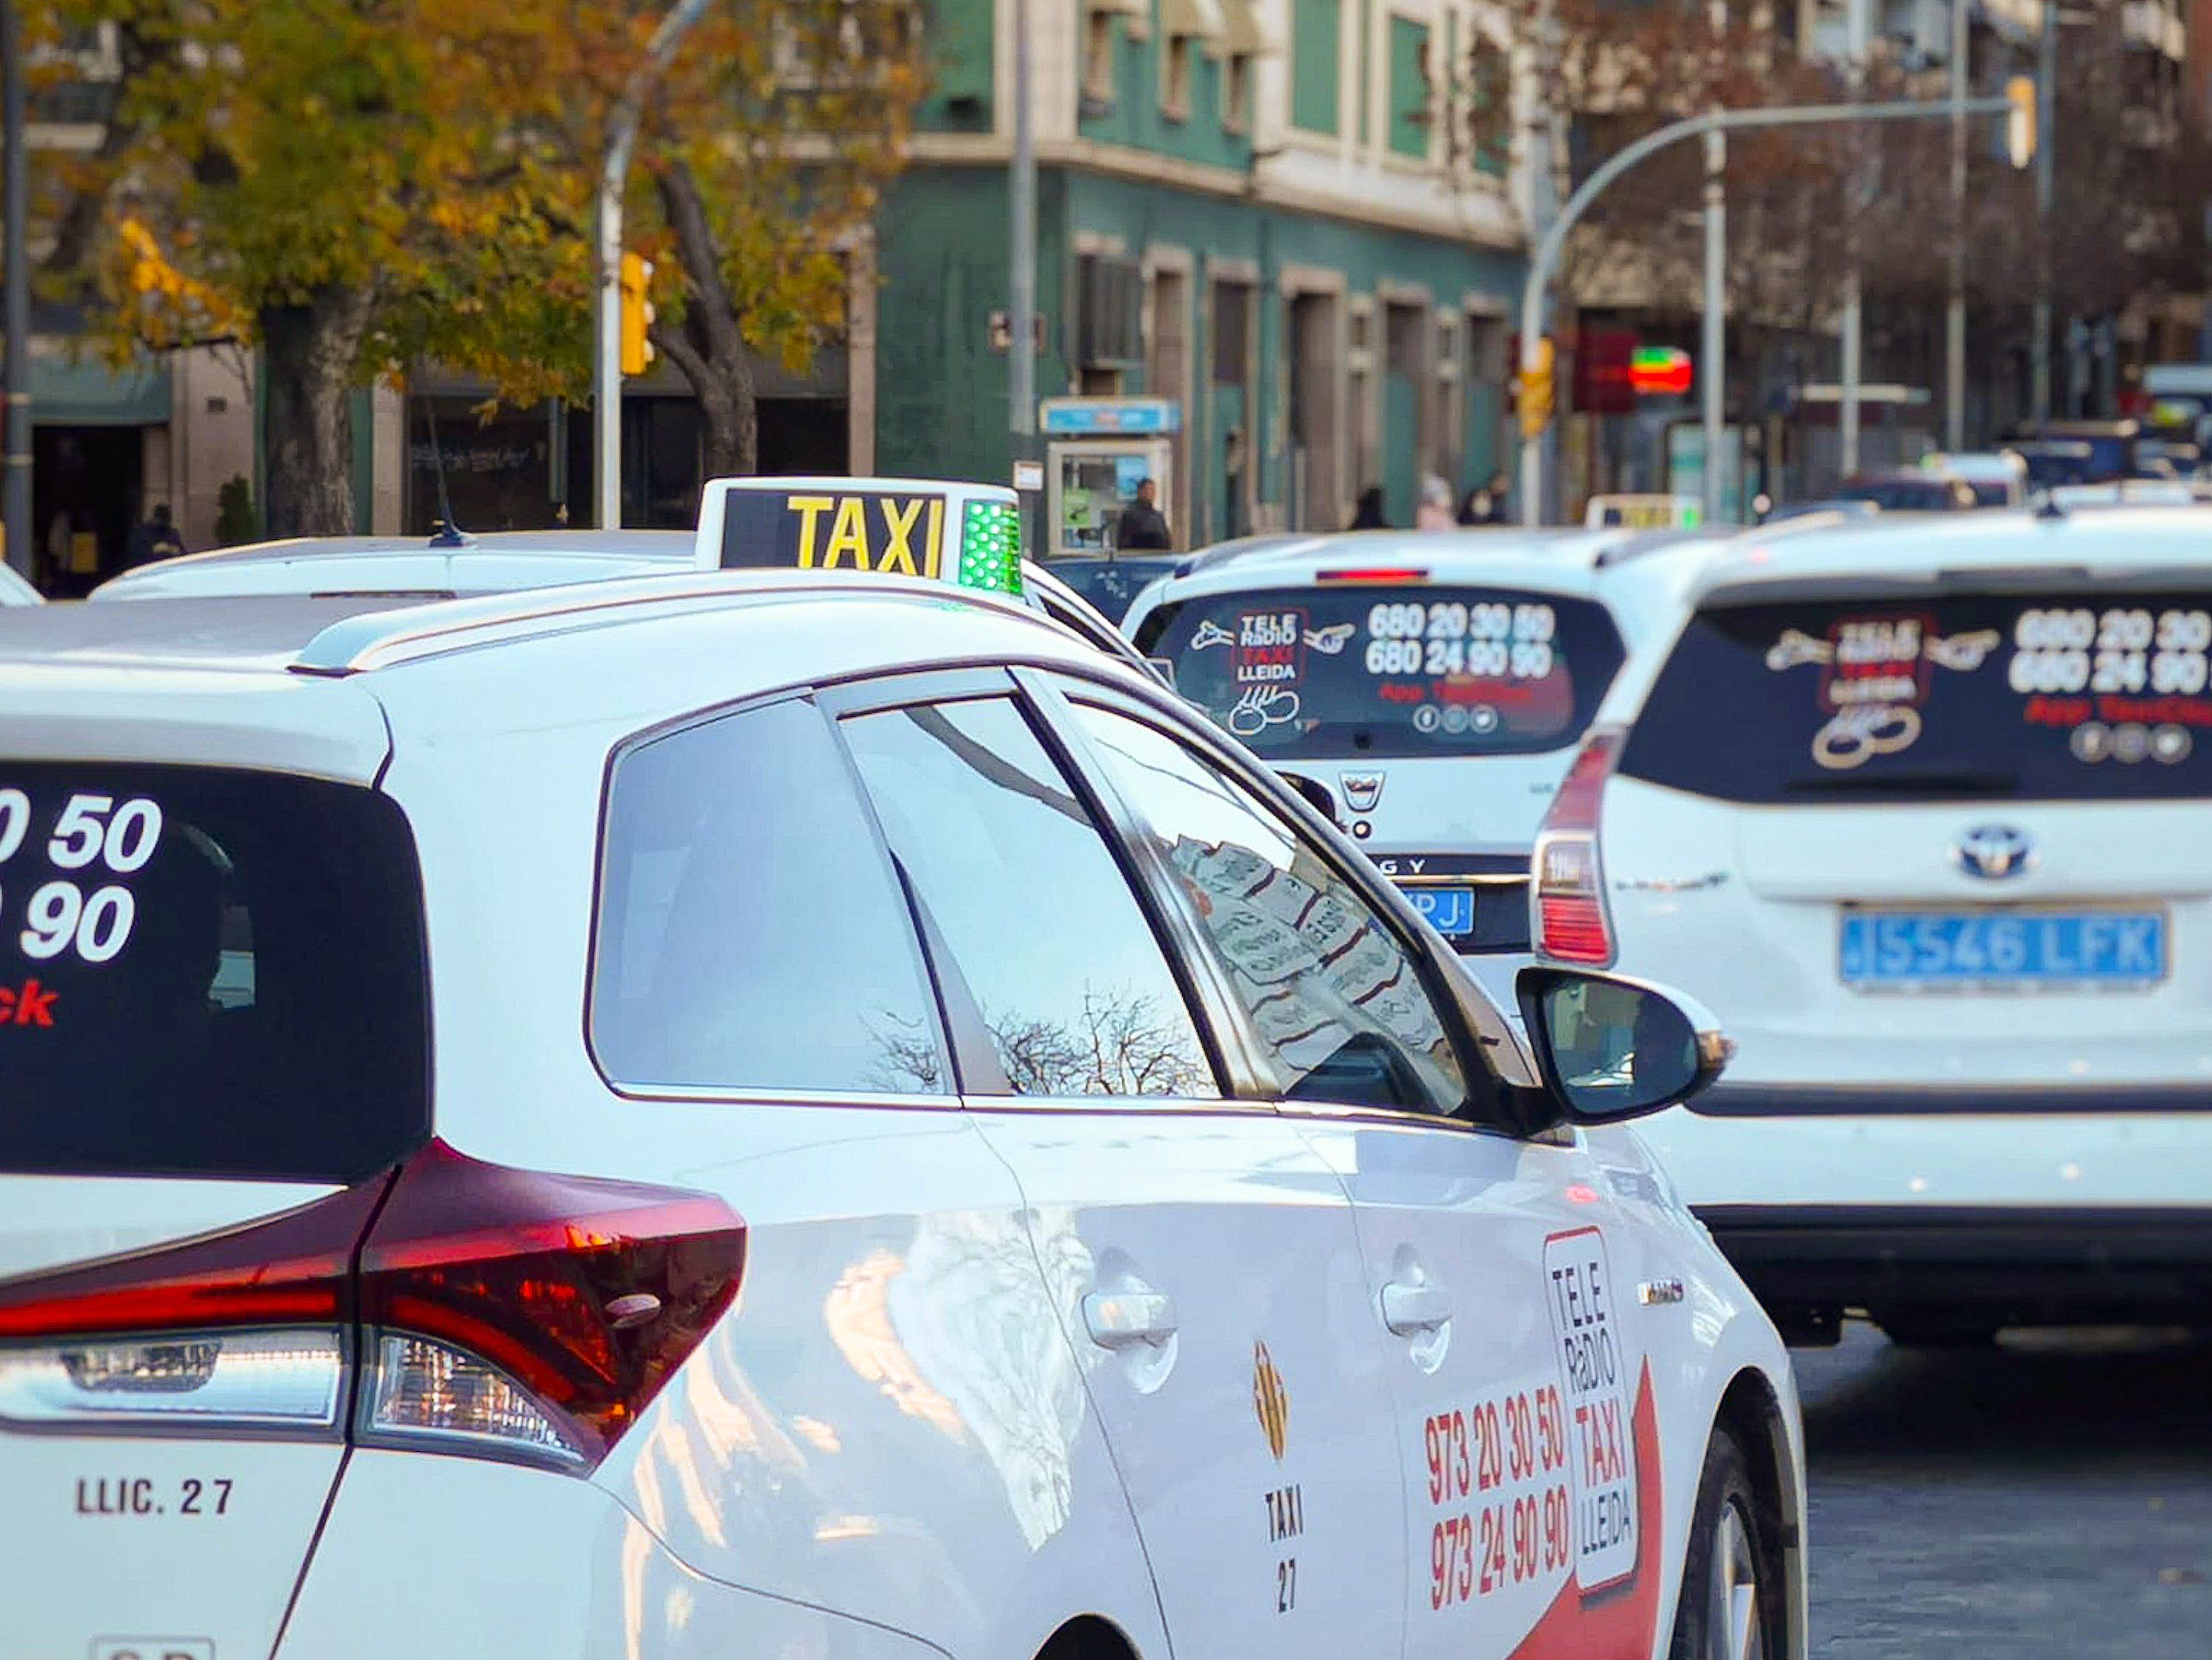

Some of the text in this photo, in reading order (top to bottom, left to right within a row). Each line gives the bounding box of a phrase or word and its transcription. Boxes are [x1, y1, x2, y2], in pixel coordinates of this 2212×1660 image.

[787, 496, 944, 580] TAXI
[1241, 614, 1297, 630] TELE
[1368, 603, 1426, 639] 680
[1427, 602, 1468, 639] 20
[1237, 664, 1295, 681] LLEIDA
[1244, 646, 1295, 663] TAXI
[1366, 639, 1422, 674] 680
[1425, 639, 1464, 675] 24
[48, 793, 162, 872] 50
[20, 881, 134, 962] 90
[1552, 1263, 1604, 1330] TELE
[1426, 1384, 1564, 1505] 973 20 30 50
[1576, 1397, 1627, 1488] TAXI
[77, 1478, 234, 1515] LLIC. 27
[1265, 1483, 1303, 1542] TAXI
[1581, 1490, 1632, 1555] LLEIDA
[1432, 1484, 1568, 1611] 973 24 90 90
[1279, 1558, 1296, 1613] 27
